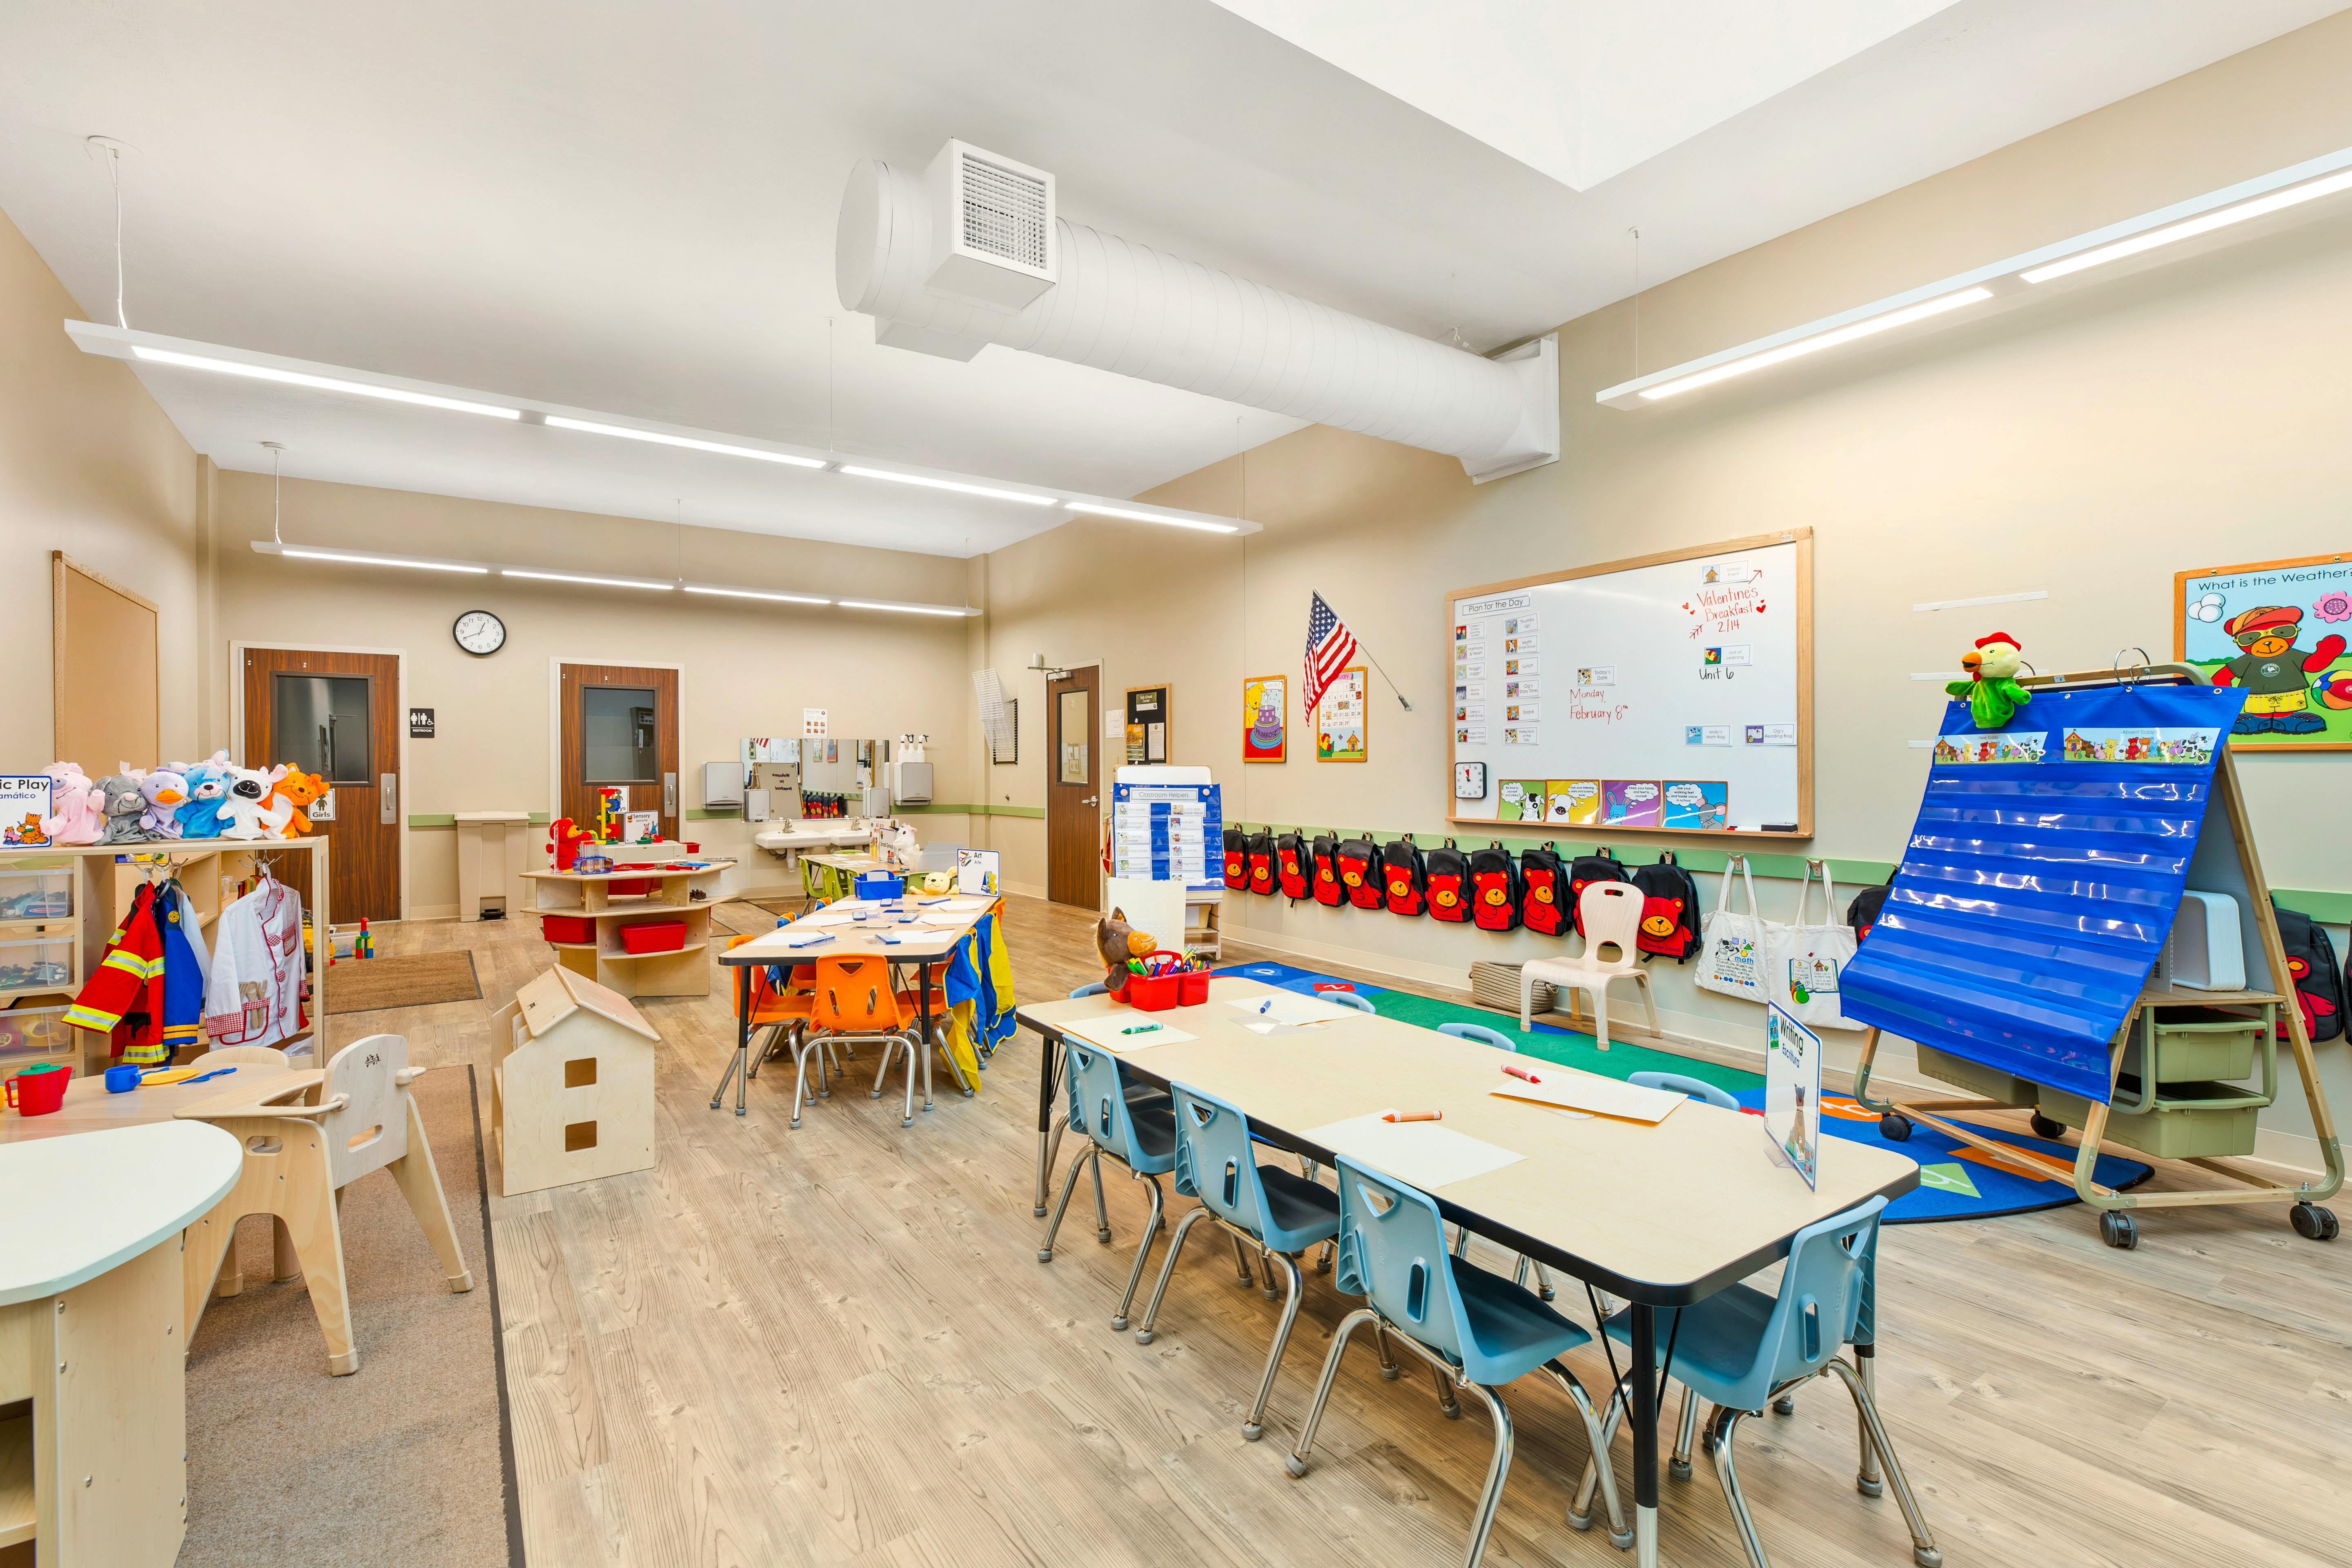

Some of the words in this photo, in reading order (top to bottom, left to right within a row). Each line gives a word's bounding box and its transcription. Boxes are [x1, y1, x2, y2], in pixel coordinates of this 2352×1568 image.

[2198, 579, 2235, 591] What
[2240, 579, 2248, 587] is
[2253, 577, 2276, 586] the
[1509, 599, 1523, 607] Day
[1697, 586, 1758, 608] Valentine's
[1705, 601, 1753, 622] Breakfast
[1717, 619, 1740, 633] 2/14
[1699, 668, 1721, 680] Unit
[1726, 668, 1734, 679] 6
[1570, 705, 1611, 724] February
[1615, 705, 1628, 720] 8th
[1255, 728, 1279, 738] PRIMROSE
[18, 780, 49, 791] Play
[1780, 1015, 1804, 1057] Writing
[1782, 1043, 1800, 1068] Escritura
